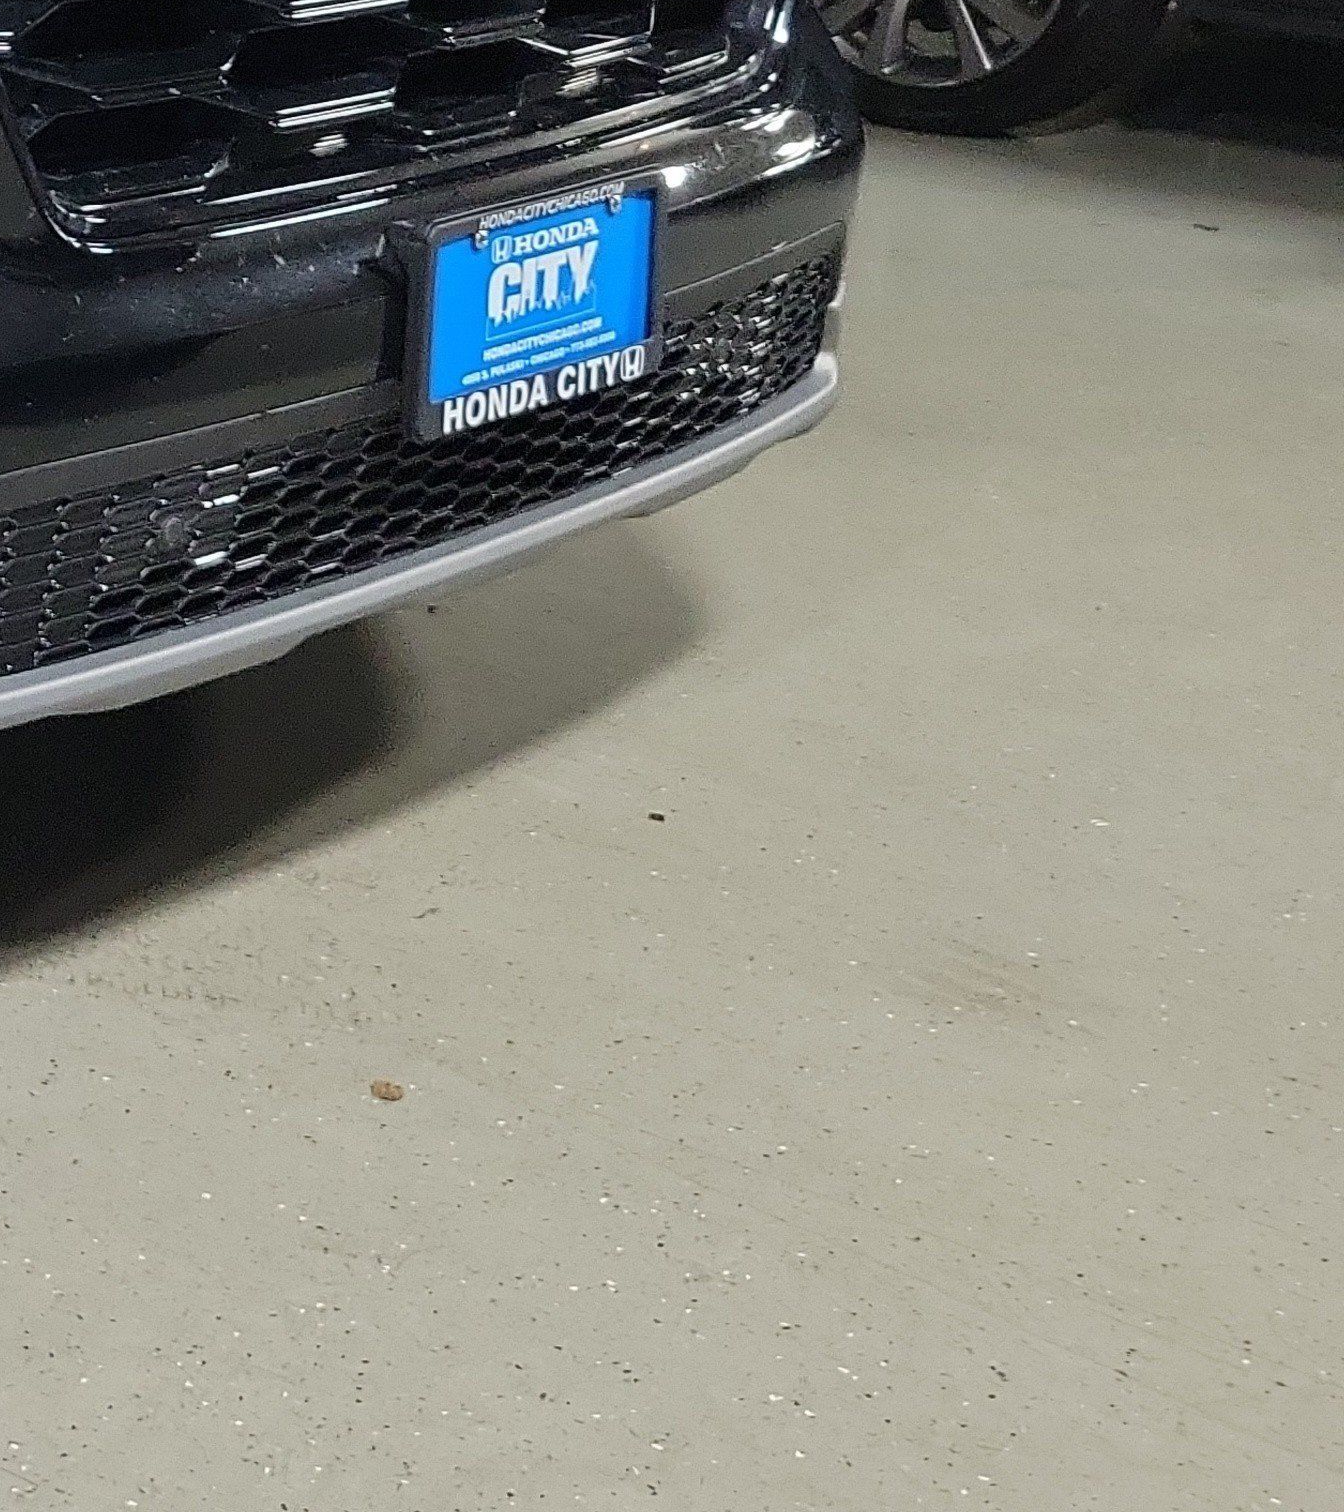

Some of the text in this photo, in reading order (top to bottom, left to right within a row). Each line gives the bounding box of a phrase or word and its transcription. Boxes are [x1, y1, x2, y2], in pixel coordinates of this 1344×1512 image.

[513, 217, 600, 256] HONDA
[487, 240, 599, 328] CITY
[442, 374, 549, 435] HONDA
[557, 351, 621, 400] CITY
